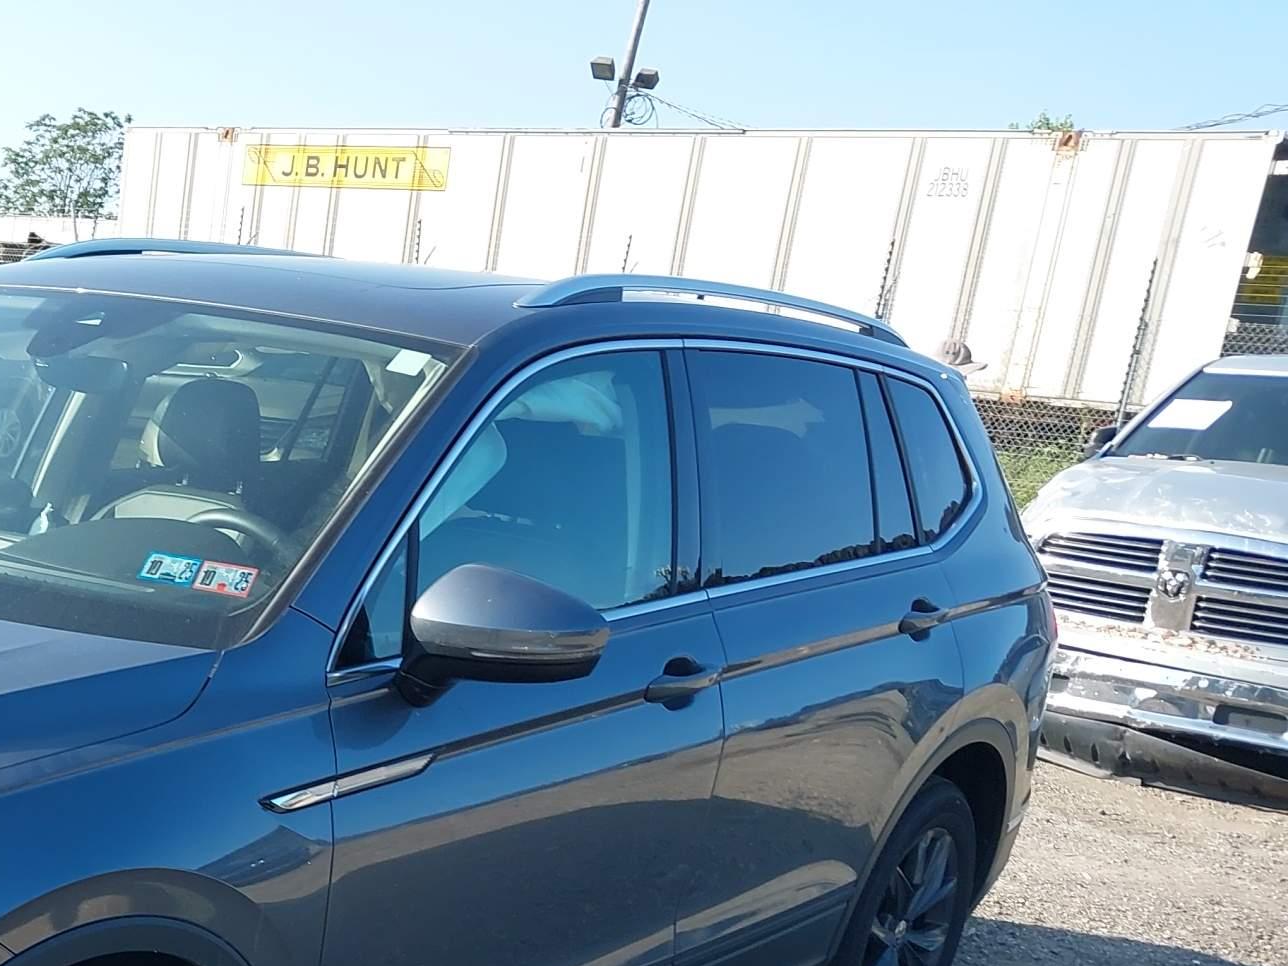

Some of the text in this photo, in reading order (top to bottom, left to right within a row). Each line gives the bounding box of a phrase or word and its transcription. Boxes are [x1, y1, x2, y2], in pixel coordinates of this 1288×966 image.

[333, 156, 407, 179] HUNT
[933, 166, 969, 182] JBHU
[146, 559, 198, 581] 10 25
[199, 568, 254, 592] 10 25
